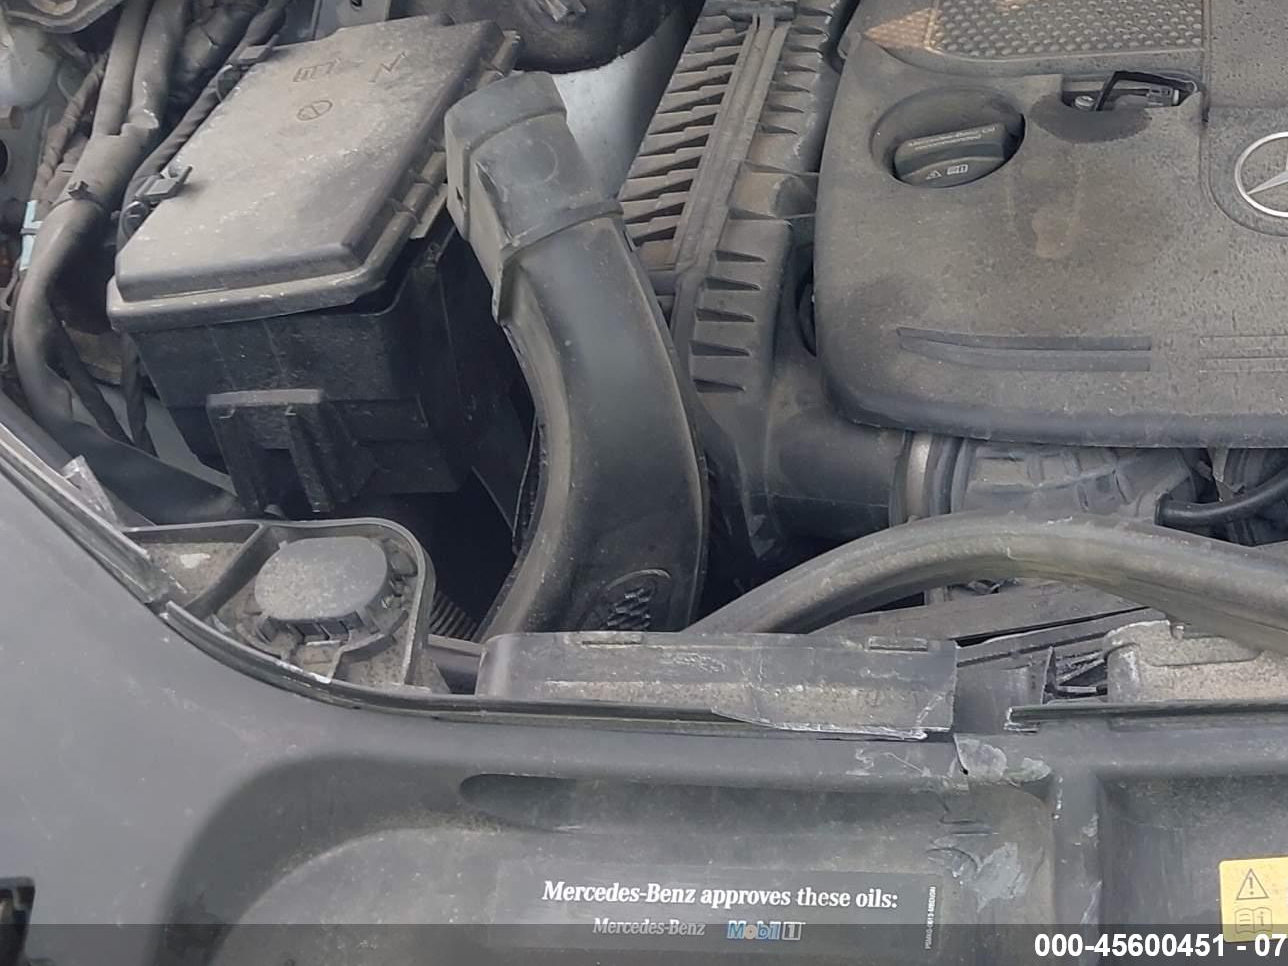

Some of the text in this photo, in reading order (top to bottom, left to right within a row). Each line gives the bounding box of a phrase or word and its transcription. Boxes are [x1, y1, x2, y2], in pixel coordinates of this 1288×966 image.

[542, 880, 898, 909] Mercedes-Benz approves these oils:
[592, 917, 706, 936] Mercedes-Benz
[727, 920, 781, 940] Mobil
